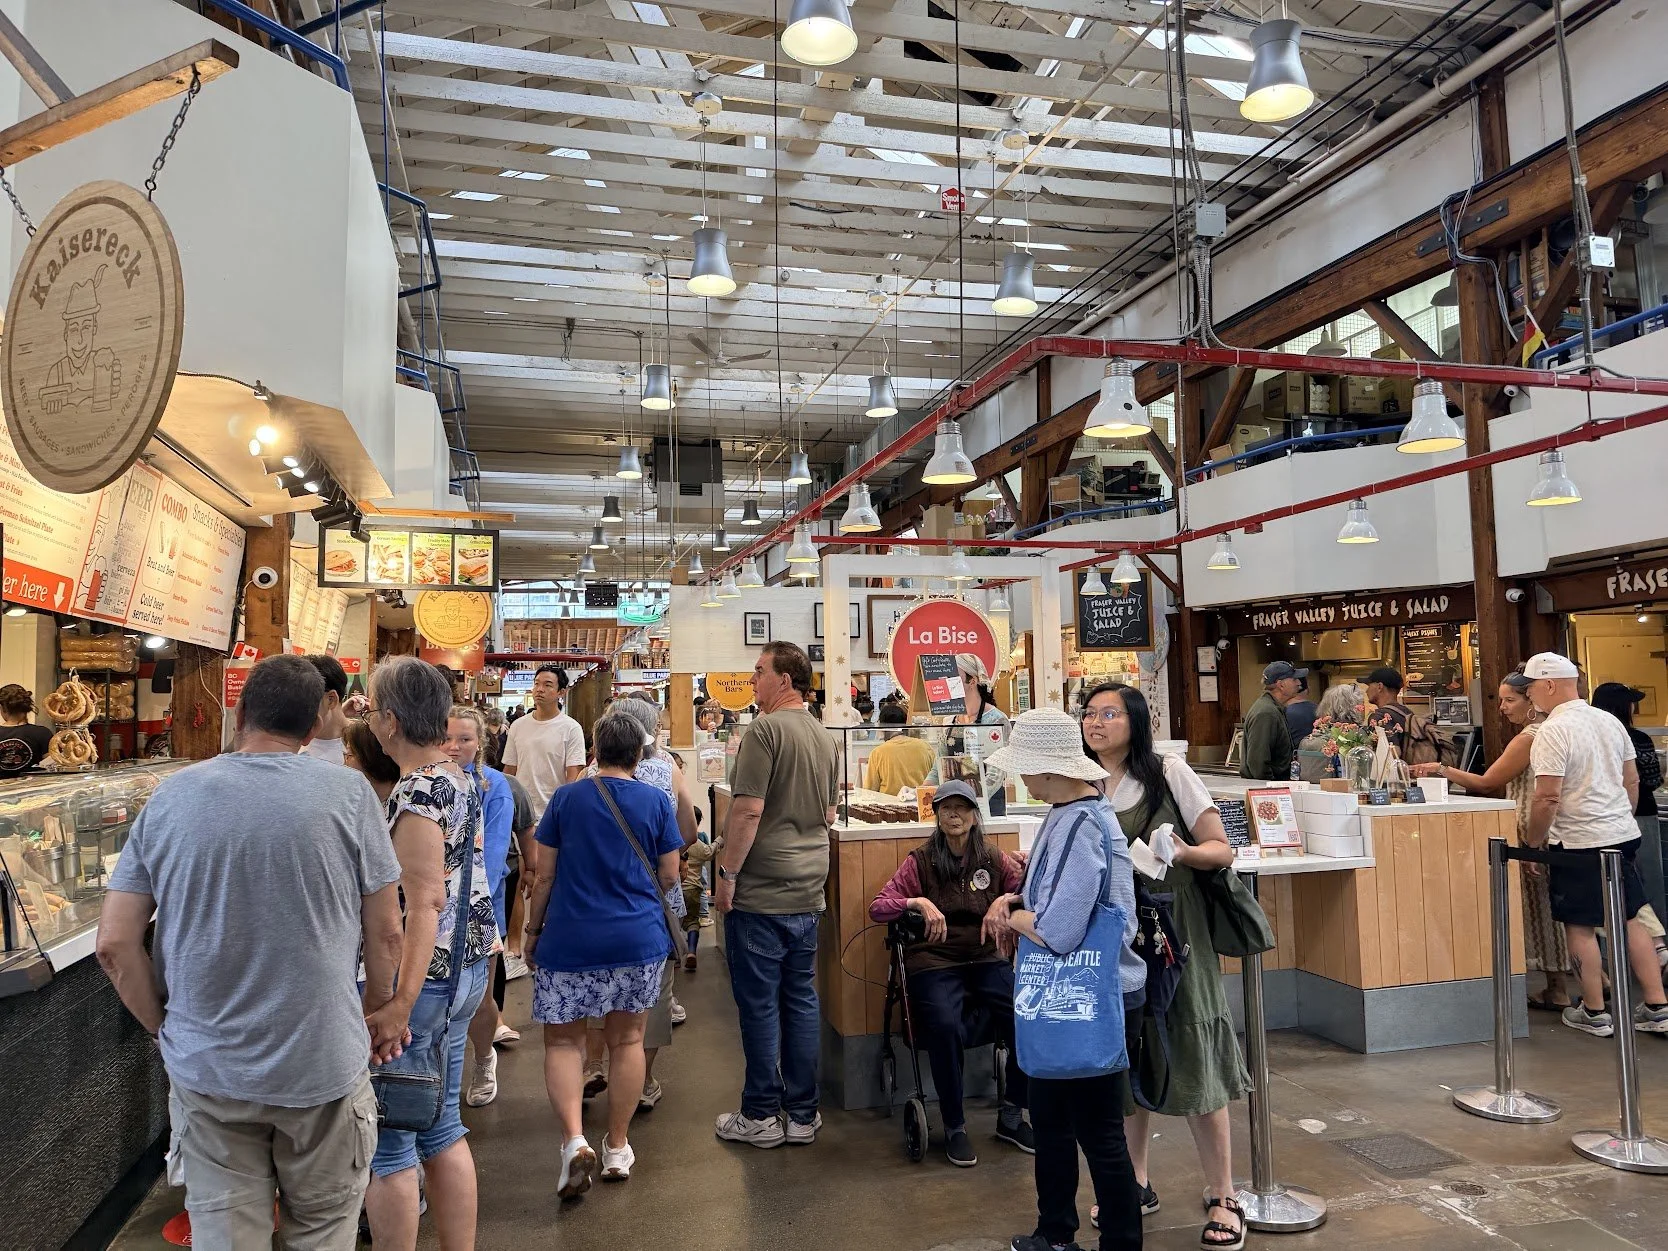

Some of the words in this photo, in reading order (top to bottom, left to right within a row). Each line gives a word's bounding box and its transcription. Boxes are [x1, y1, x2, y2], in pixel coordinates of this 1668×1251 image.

[945, 201, 960, 210] Ven
[29, 227, 141, 310] Kaisereck
[29, 415, 60, 453] SAUSAGES
[65, 423, 116, 456] SANDWICHES
[120, 354, 147, 416] PEROGIES
[120, 474, 153, 513] BEER
[161, 493, 188, 523] COMBO
[192, 503, 214, 530] Snacks
[19, 573, 48, 602] here
[140, 592, 154, 608] Cold
[428, 590, 480, 604] Kaeck
[1090, 598, 1113, 608] FRASER
[1115, 597, 1137, 605] VALLEY
[132, 609, 152, 622] served
[1092, 606, 1124, 619] JUICE
[1252, 610, 1290, 631] FRASER
[1294, 606, 1335, 624] VALLEY
[1342, 601, 1383, 621] JUICE
[1390, 599, 1399, 616] &
[1406, 595, 1449, 619] SALAD
[1093, 618, 1122, 632] SALAD
[908, 626, 933, 645] La
[938, 625, 978, 644] Bise
[514, 642, 525, 651] EXIT
[1028, 952, 1053, 963] PUBLIC
[1063, 950, 1101, 967] SEATTLE
[1020, 963, 1044, 973] MARKET
[1020, 975, 1046, 984] CENTER
